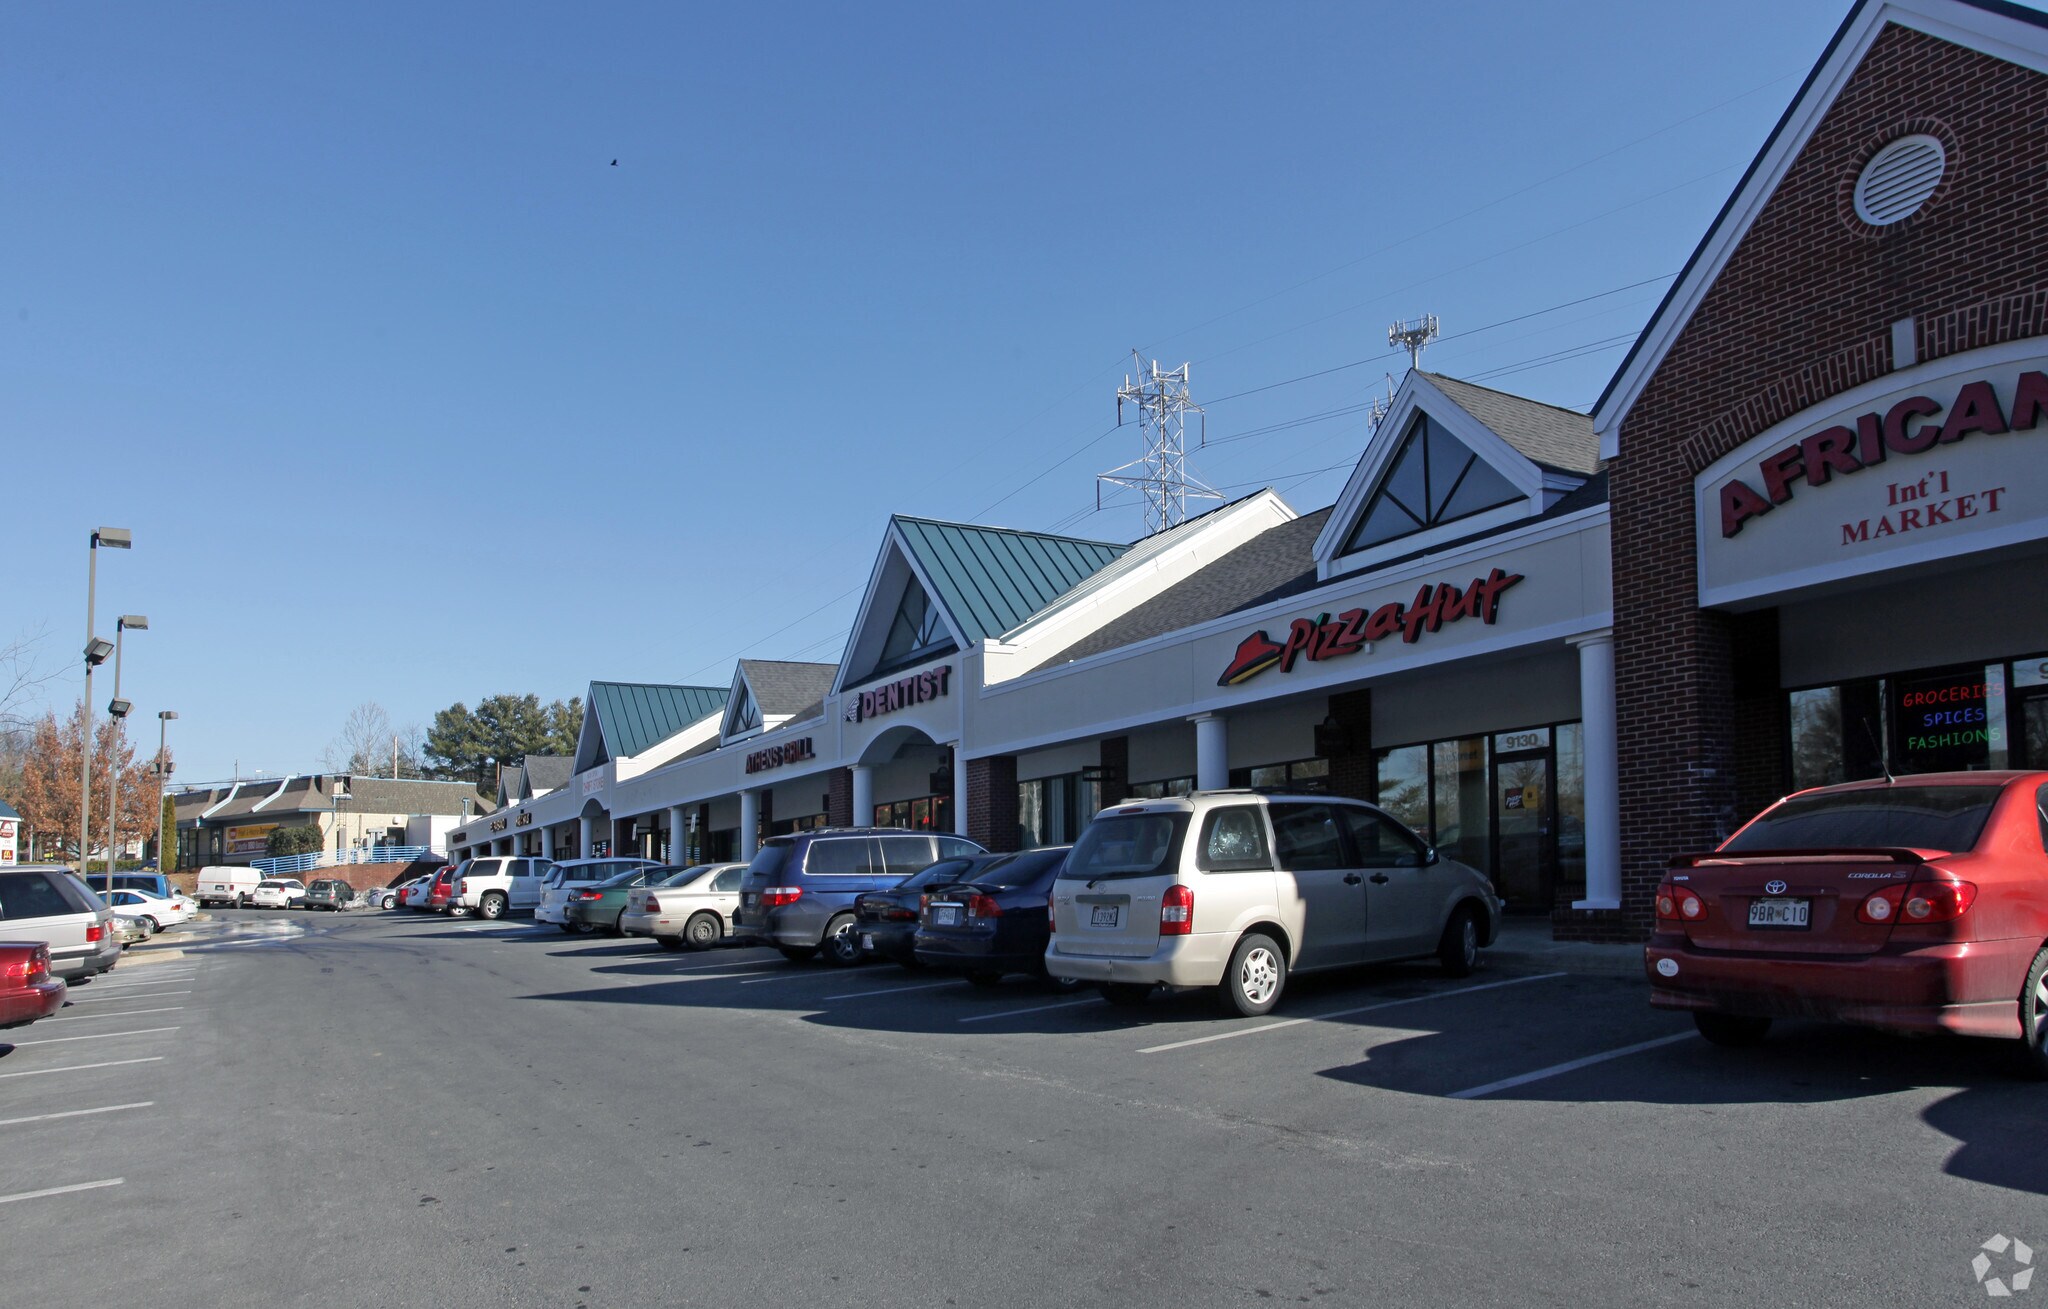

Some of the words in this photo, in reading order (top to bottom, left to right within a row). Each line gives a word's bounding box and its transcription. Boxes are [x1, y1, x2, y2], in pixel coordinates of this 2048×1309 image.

[1886, 470, 1951, 507] Int'l
[1841, 487, 2006, 546] MARKET
[1280, 601, 1405, 673] Pizza
[1402, 567, 1525, 643] Hut
[863, 665, 951, 719] DENTIST
[1903, 683, 2004, 707] GROCERIES
[1923, 708, 1985, 727] SPICES
[1506, 733, 1539, 749] 9130
[1908, 727, 2000, 750] FASHIONS
[745, 746, 783, 774] ATHENS
[783, 737, 815, 764] GRILL
[1893, 871, 1907, 879] S
